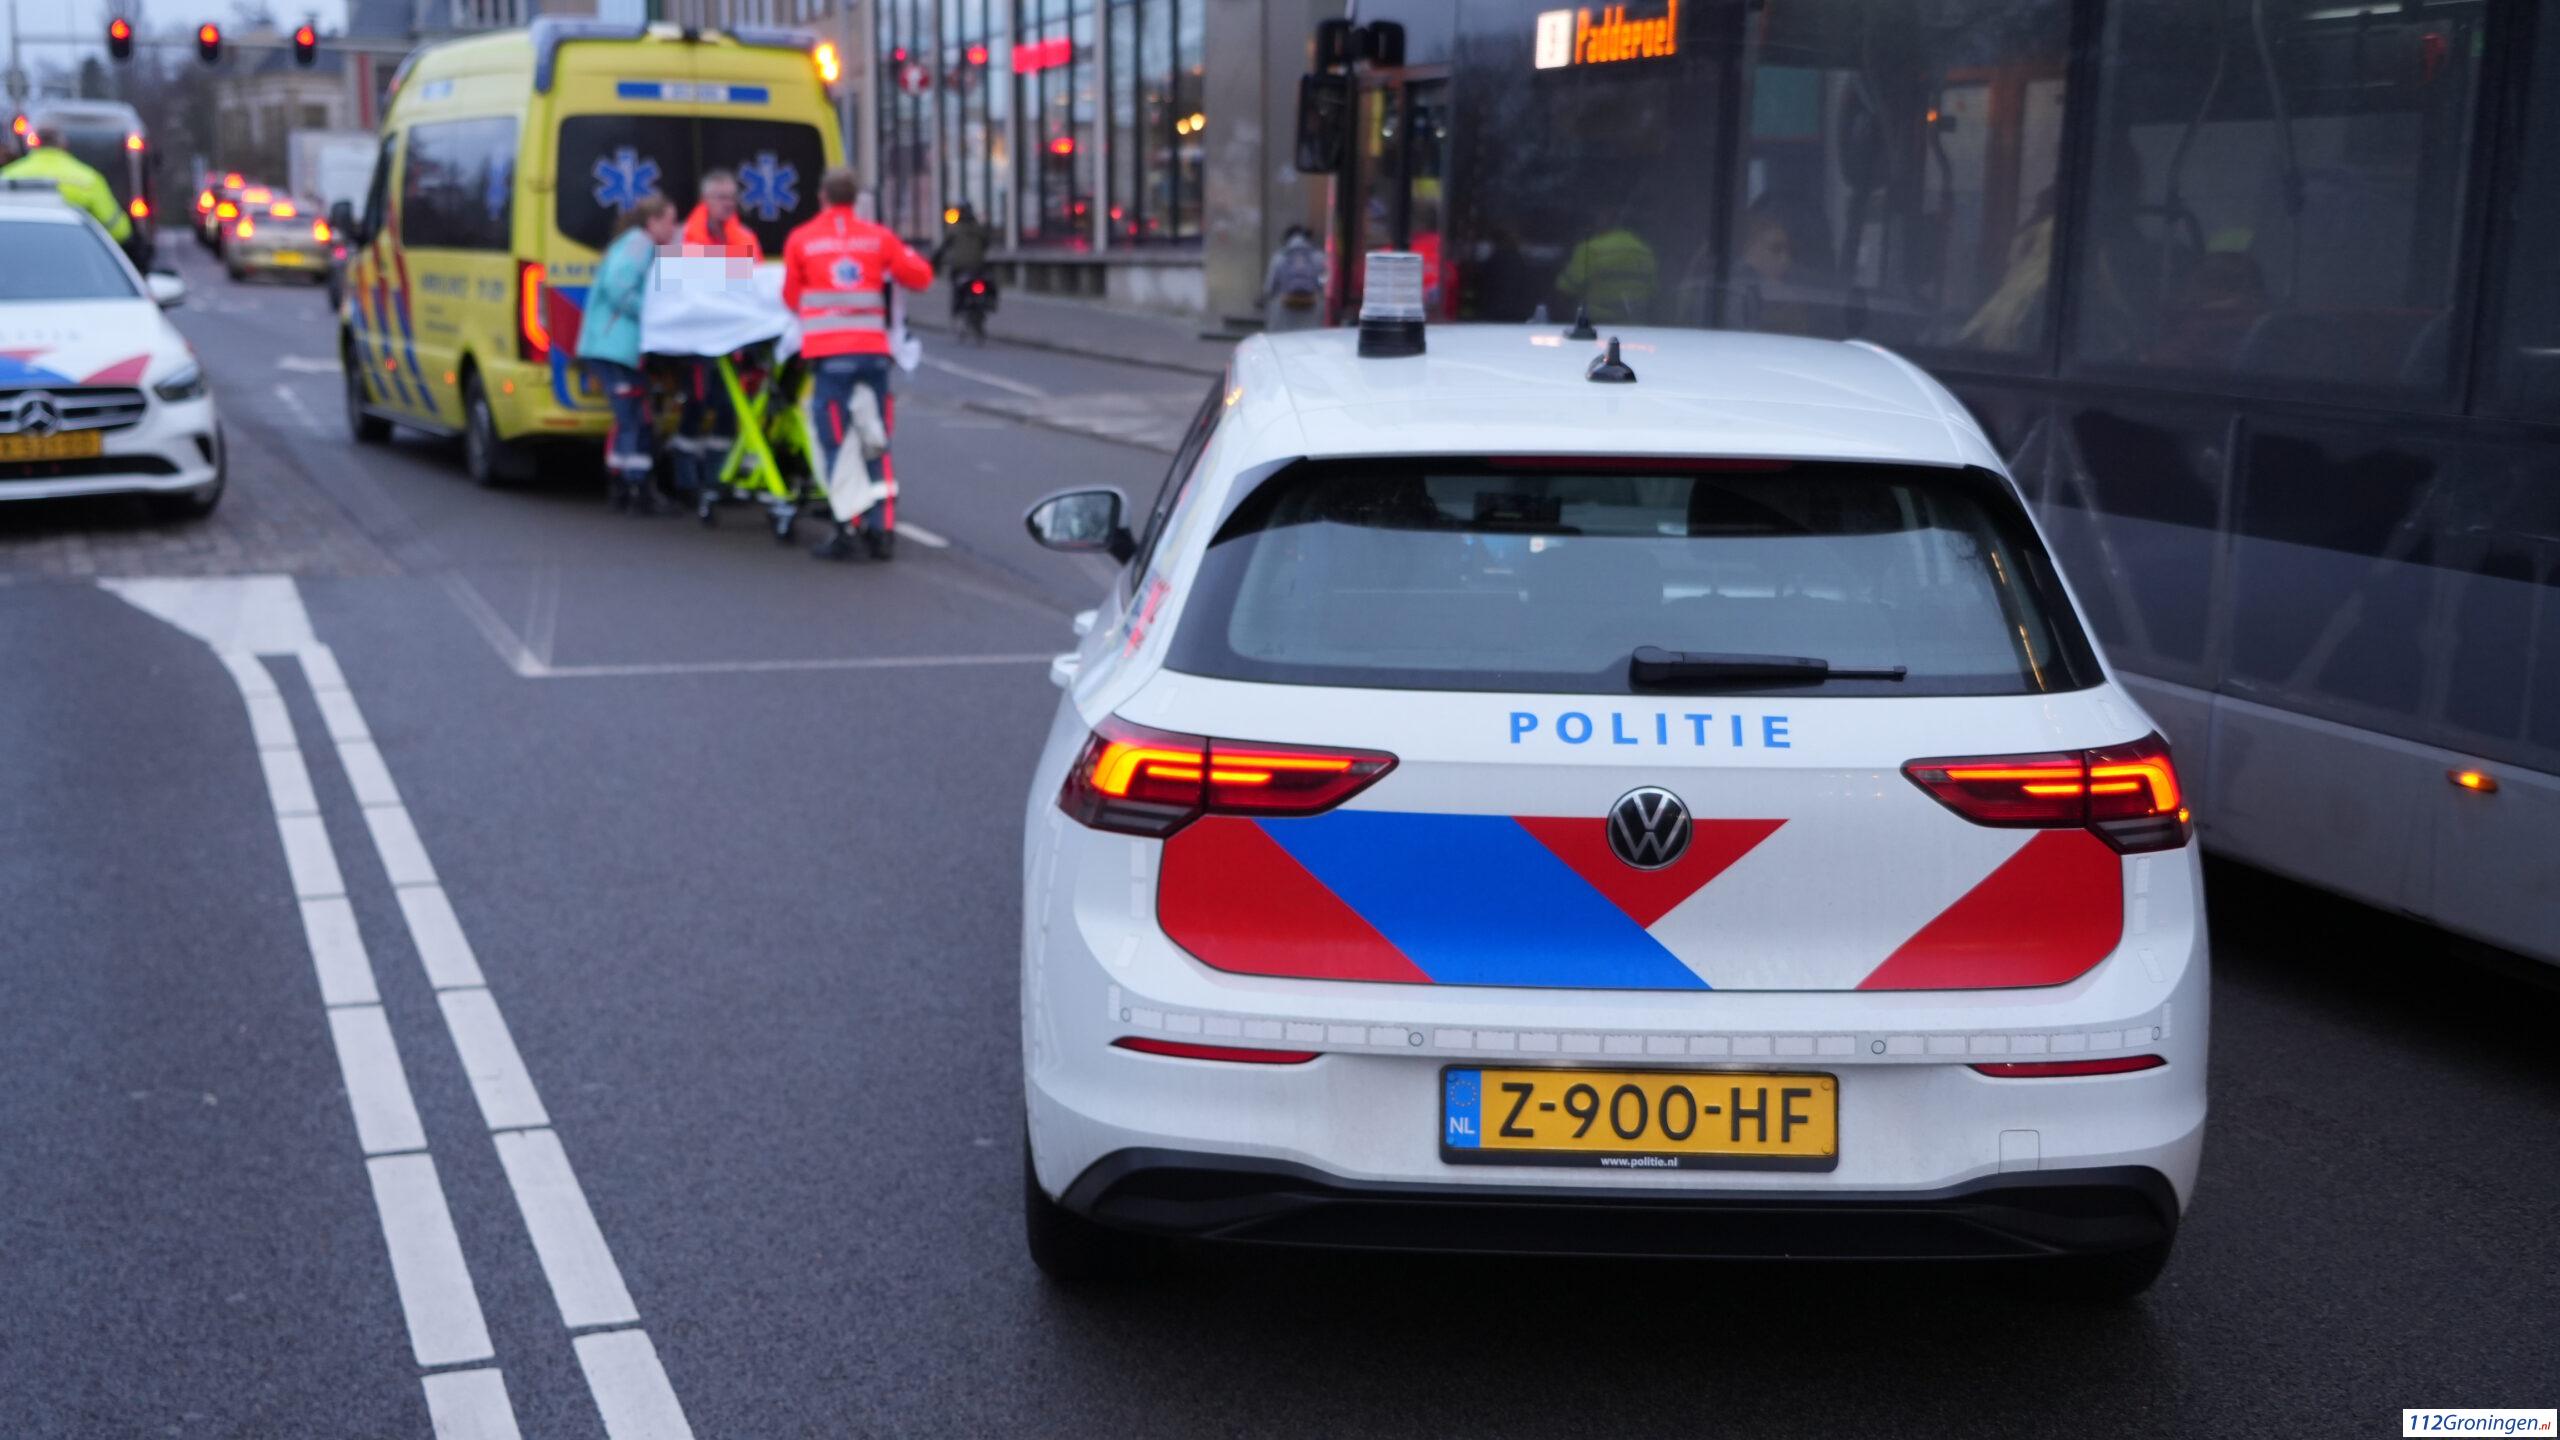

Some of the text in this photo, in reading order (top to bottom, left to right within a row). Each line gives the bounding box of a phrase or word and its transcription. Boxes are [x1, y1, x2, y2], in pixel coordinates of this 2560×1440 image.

[1509, 711, 1791, 748] POLITIE
[1499, 1082, 1812, 1142] Z-900-HF
[1449, 1117, 1475, 1135] NL
[1600, 1156, 1678, 1168] www.politie.nl
